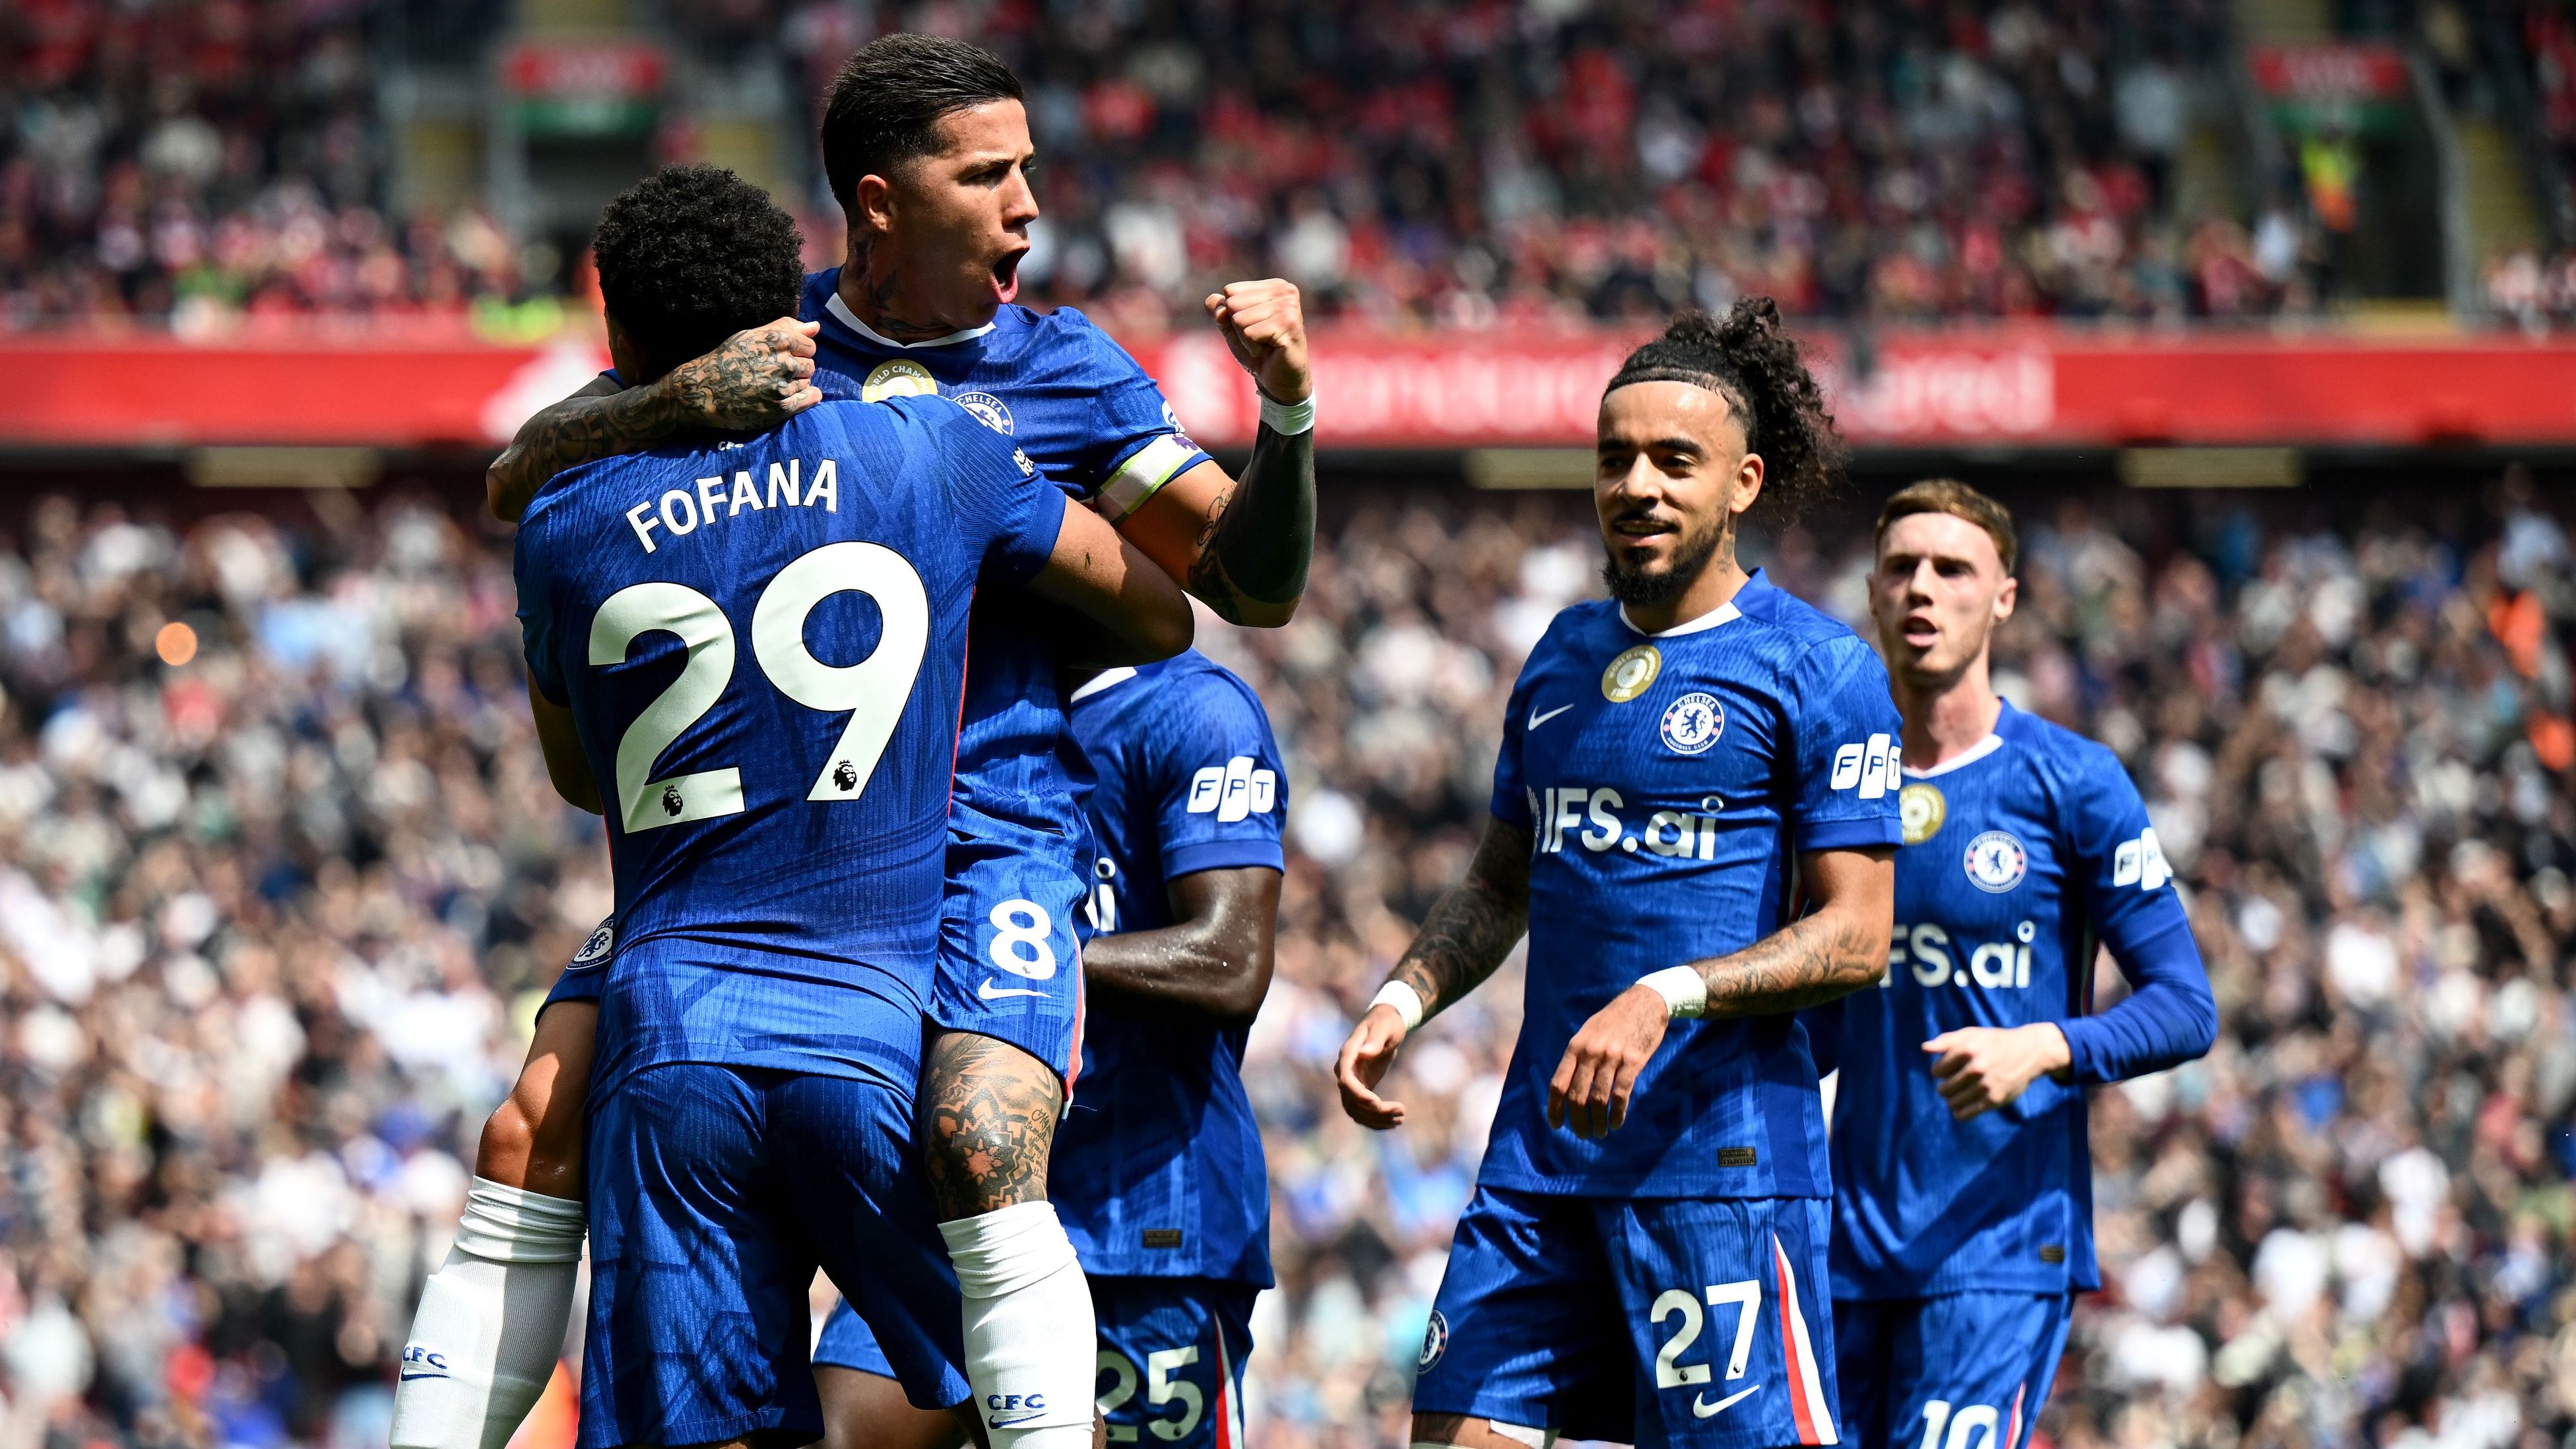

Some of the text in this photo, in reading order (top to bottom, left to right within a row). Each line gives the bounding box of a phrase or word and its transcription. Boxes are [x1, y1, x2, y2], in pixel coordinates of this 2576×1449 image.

[957, 395, 1002, 413] CHELSEA
[625, 458, 838, 554] FOFANA
[587, 540, 930, 834] 29
[1677, 695, 1716, 711] CHELSEA
[1541, 787, 1724, 860] IFS.ai
[989, 898, 1056, 981] 8
[1878, 919, 2036, 989] FS.ai
[402, 1346, 447, 1370] CFC
[1650, 1279, 1762, 1389] 27
[986, 1394, 1046, 1411] CFC
[1095, 1344, 1204, 1442] 25
